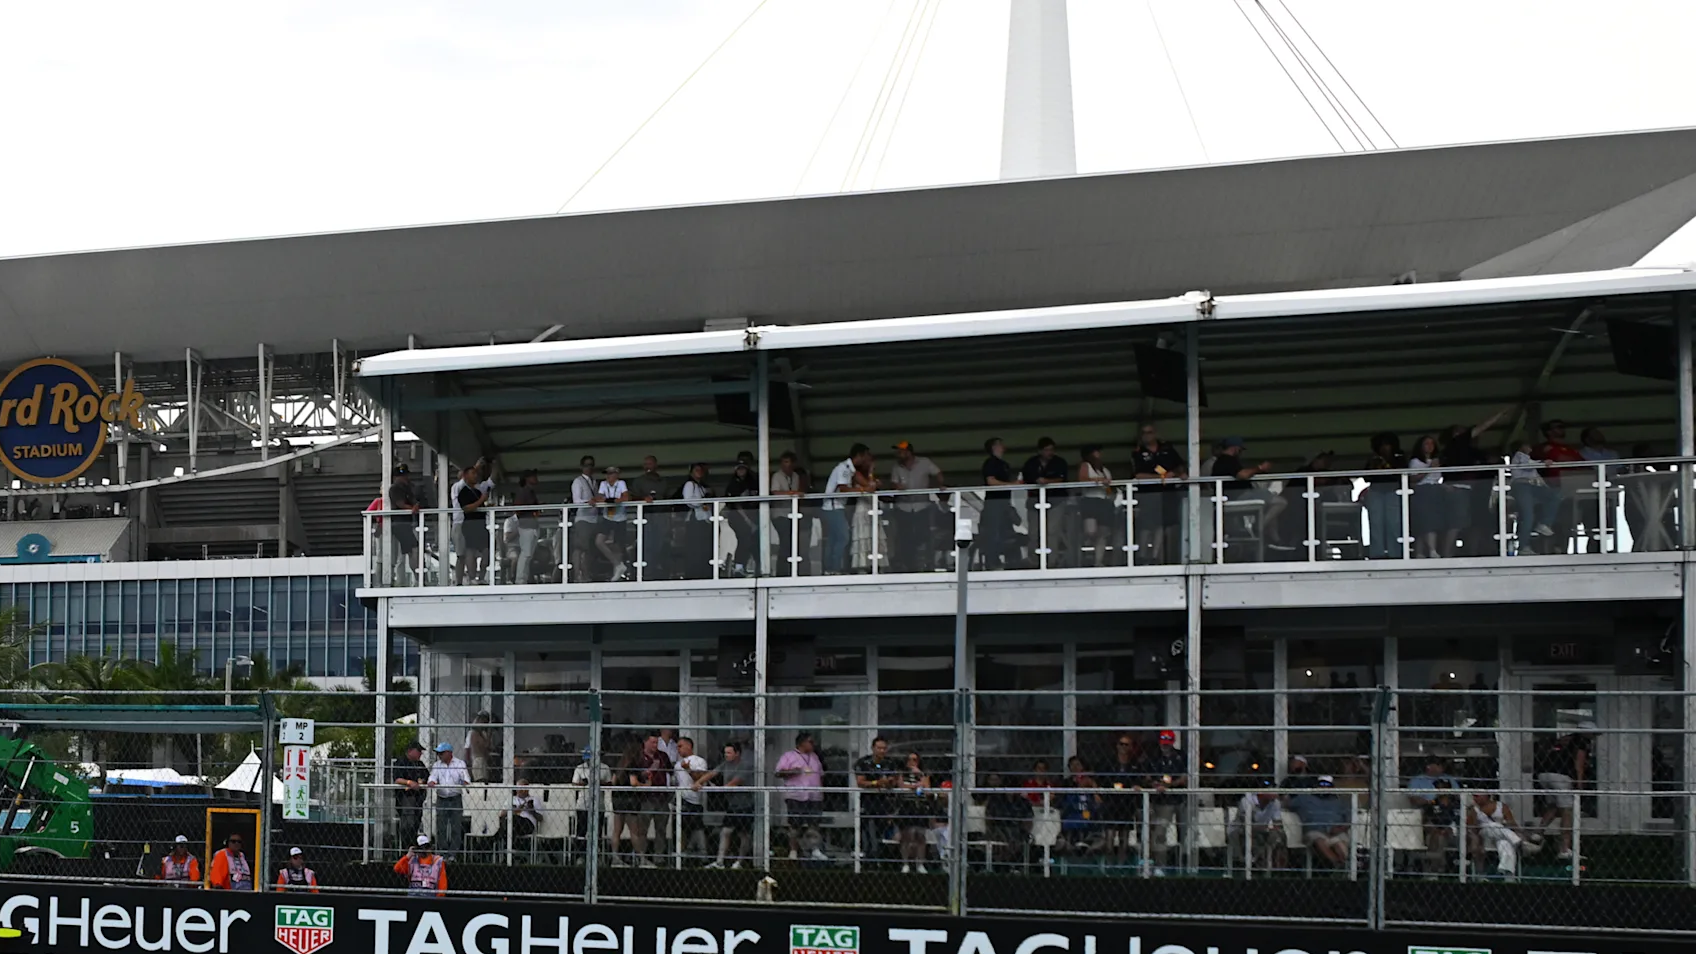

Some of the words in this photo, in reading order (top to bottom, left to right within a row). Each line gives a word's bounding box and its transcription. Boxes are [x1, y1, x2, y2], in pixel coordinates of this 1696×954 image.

[50, 378, 144, 433] Rock
[13, 443, 82, 460] STADIUM
[295, 721, 309, 730] MP
[299, 732, 304, 740] 2
[70, 821, 80, 834] 5
[280, 909, 328, 926] TAG
[278, 928, 330, 953] HEUER
[796, 929, 853, 947] TAG
